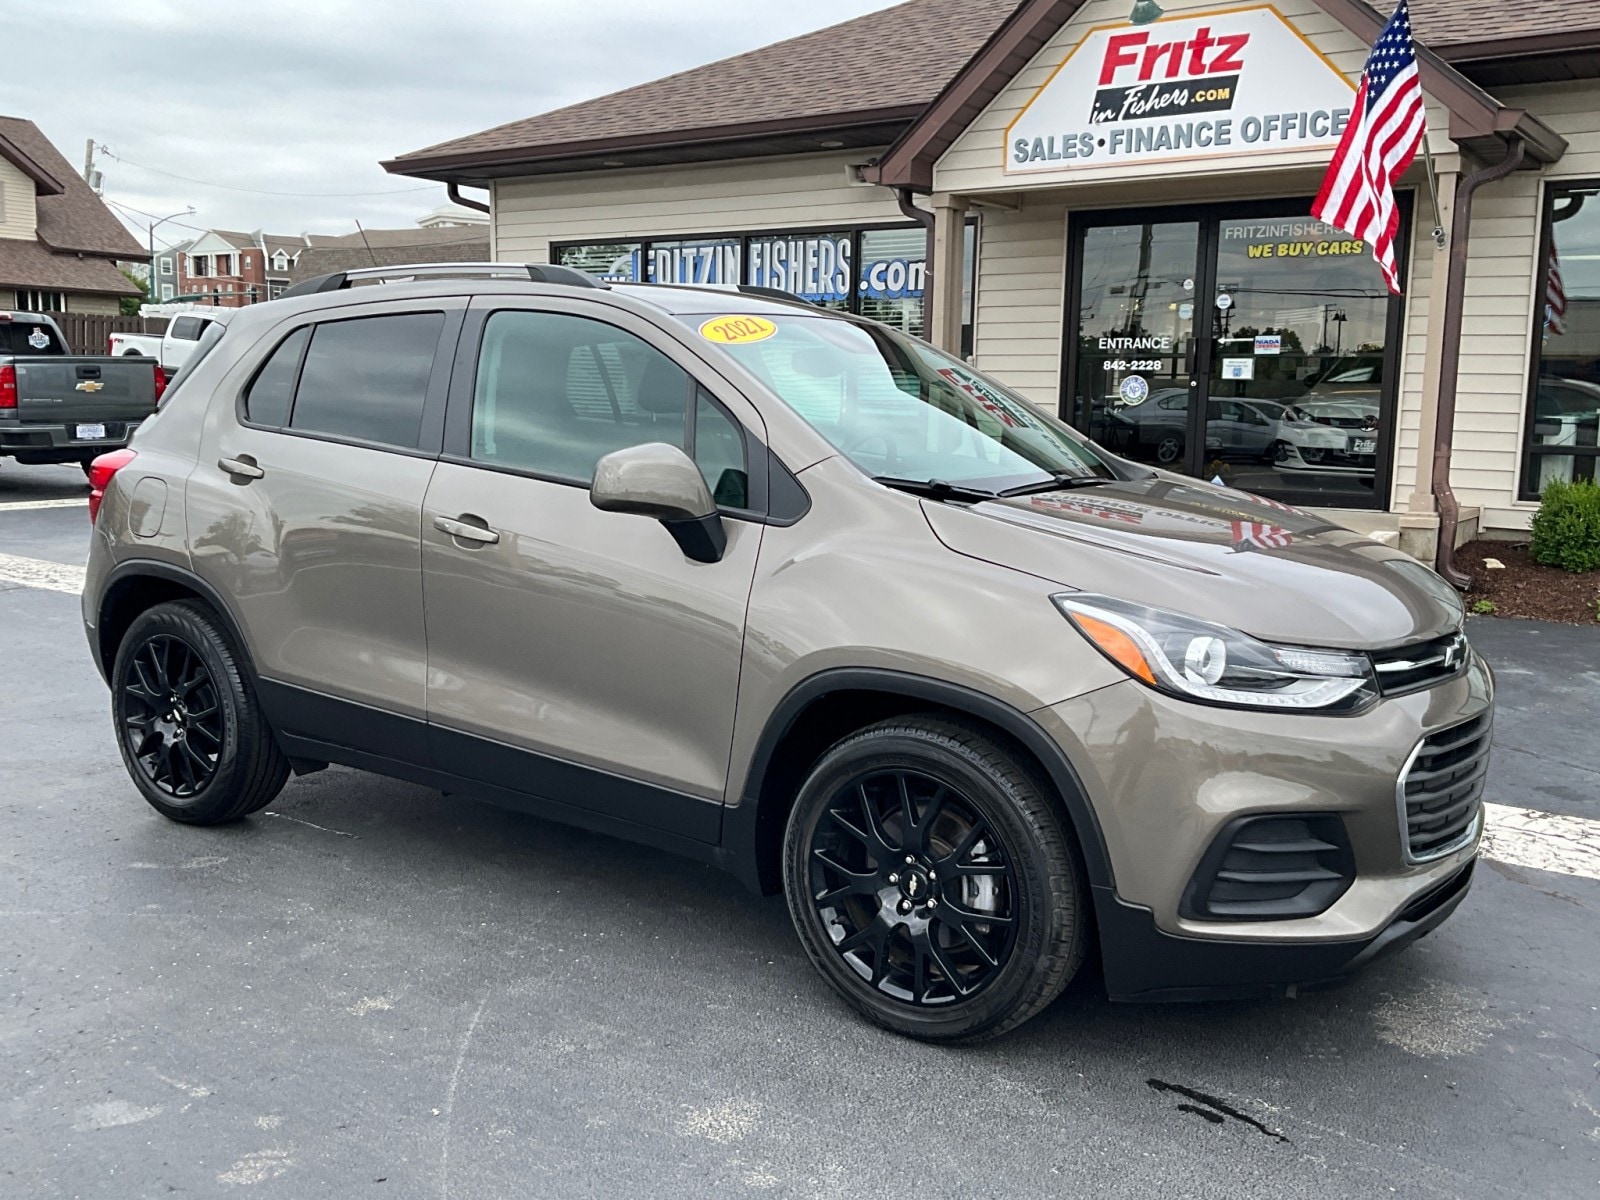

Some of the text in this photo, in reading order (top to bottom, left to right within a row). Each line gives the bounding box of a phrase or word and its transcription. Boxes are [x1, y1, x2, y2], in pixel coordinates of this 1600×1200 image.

[1098, 27, 1250, 86] Fritz
[1091, 102, 1116, 123] in
[1013, 108, 1351, 164] SALES FINANCE OFFICE
[1247, 240, 1364, 258] WE BUY CARS
[749, 238, 851, 295] FISHERS
[712, 317, 768, 341] 2021
[1098, 337, 1170, 350] ENTRANCE
[1103, 360, 1162, 371] 842-2228
